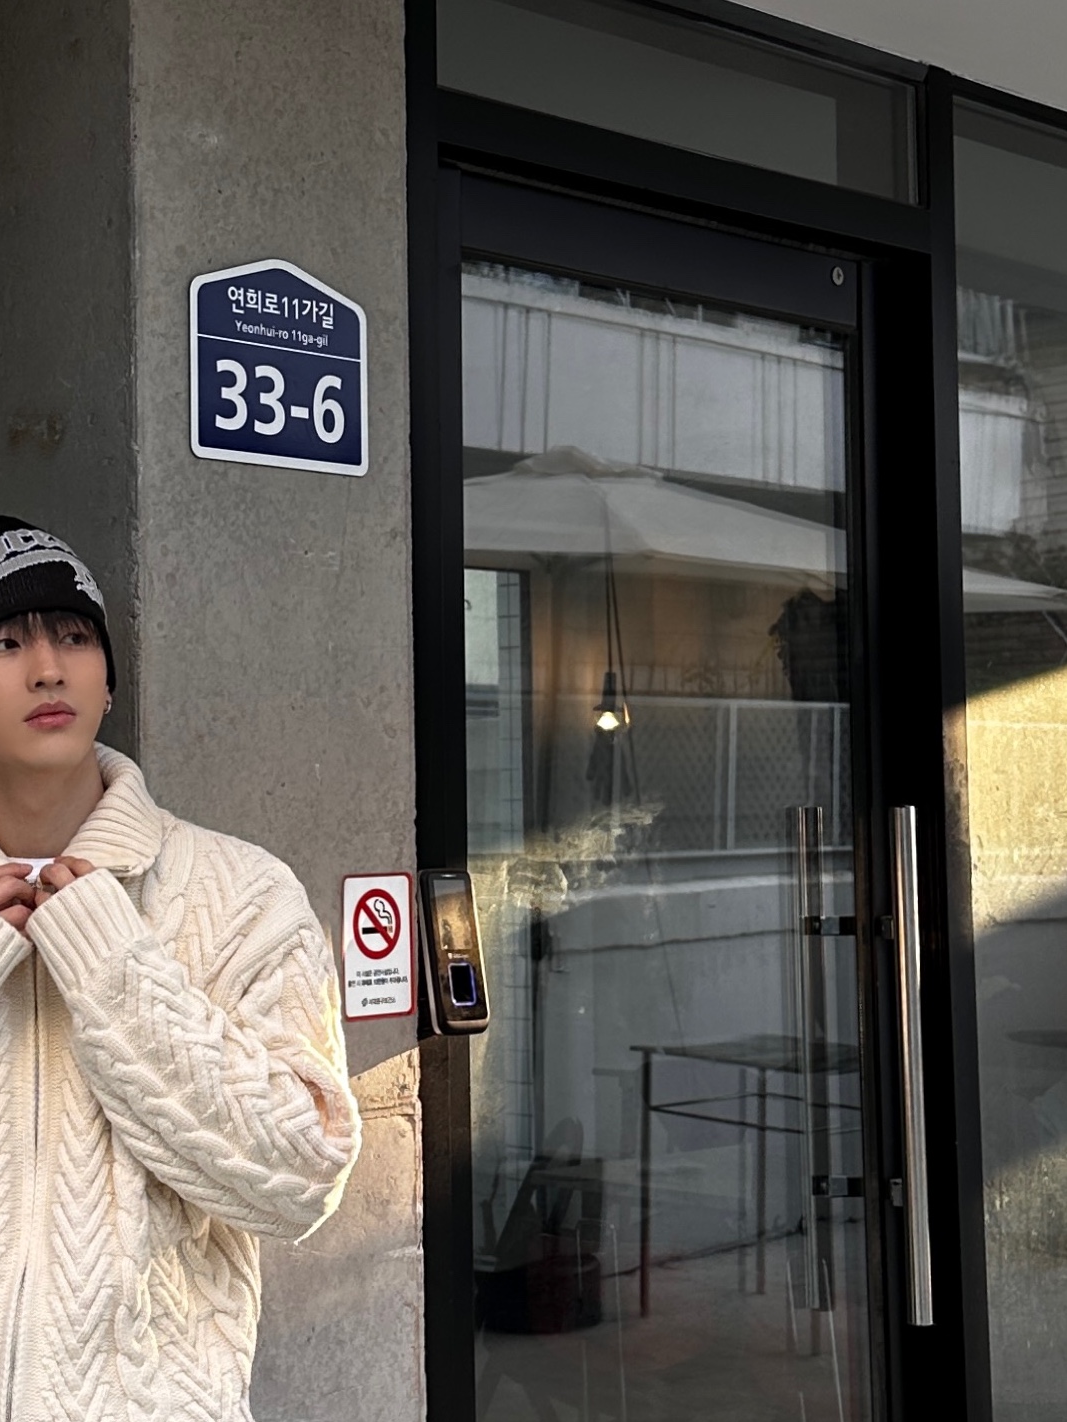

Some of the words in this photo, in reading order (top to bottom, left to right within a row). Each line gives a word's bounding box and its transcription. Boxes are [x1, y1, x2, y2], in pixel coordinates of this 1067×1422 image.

[227, 286, 334, 329] 연희로11가길
[235, 319, 289, 340] Yeonhui-ro
[291, 330, 329, 348] 11ga-gil
[215, 359, 345, 444] 33-6
